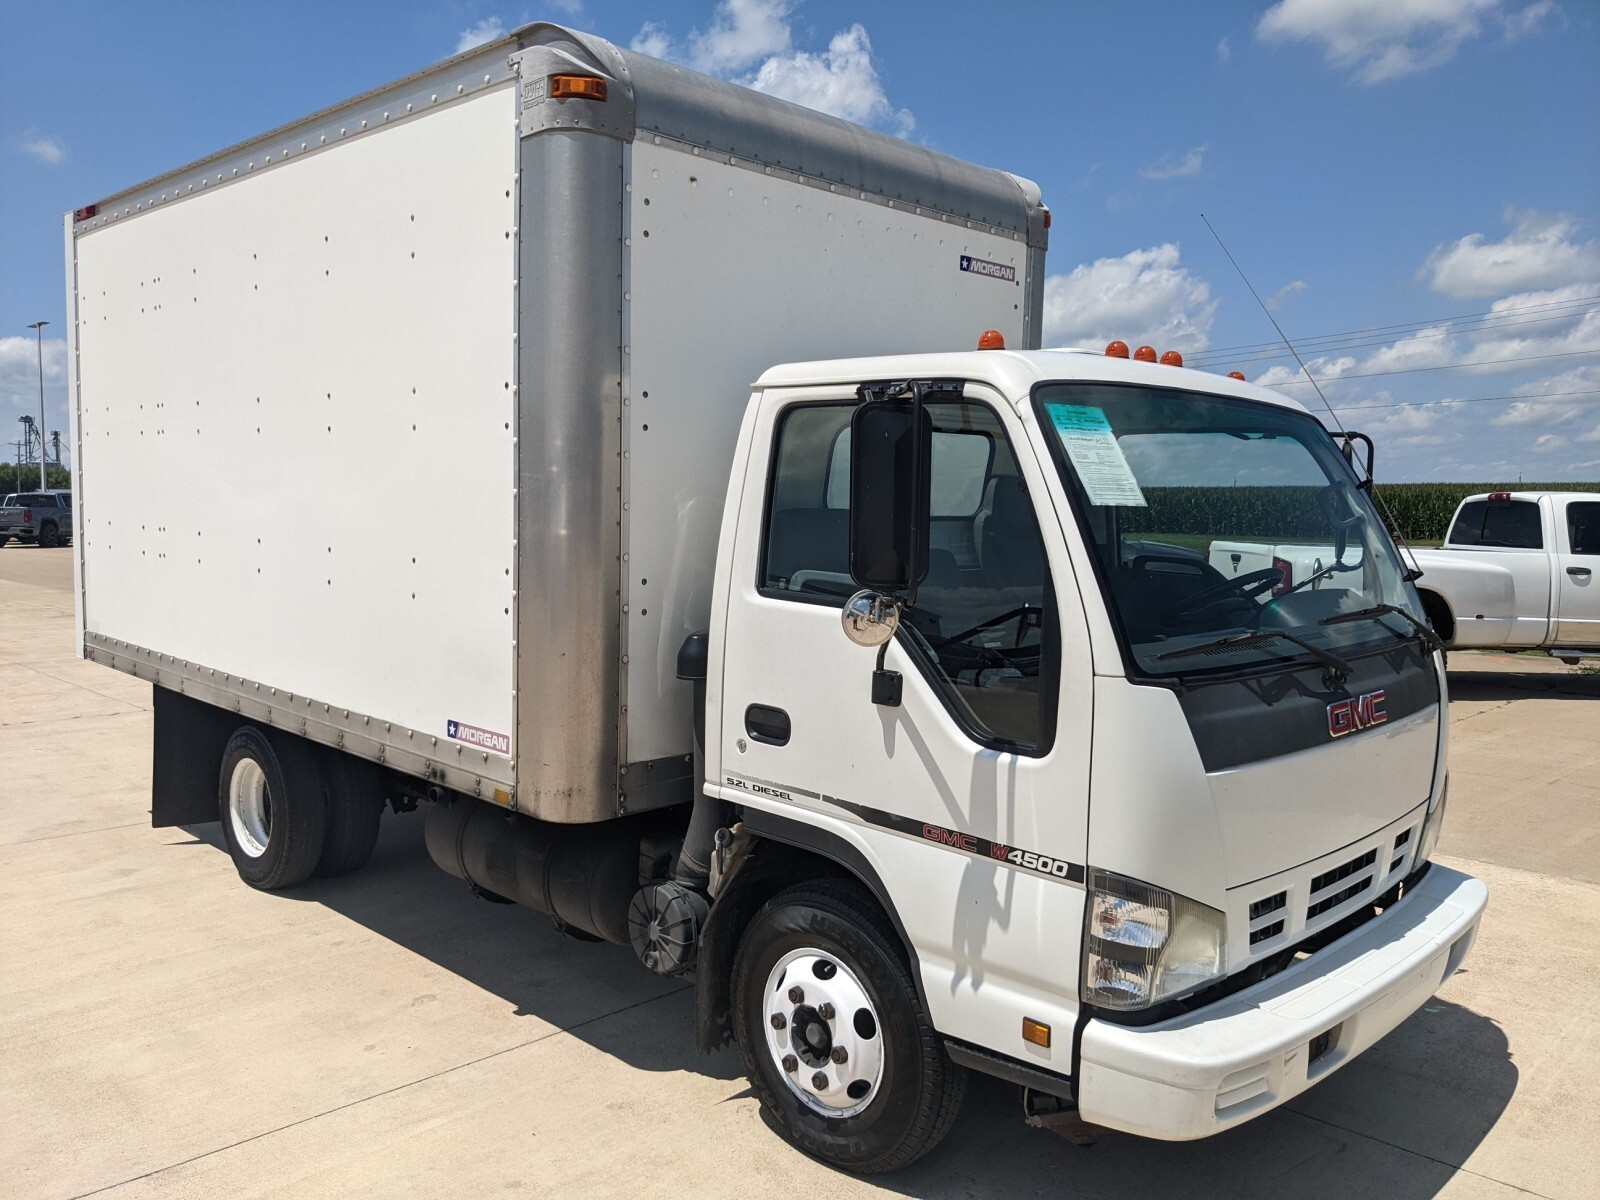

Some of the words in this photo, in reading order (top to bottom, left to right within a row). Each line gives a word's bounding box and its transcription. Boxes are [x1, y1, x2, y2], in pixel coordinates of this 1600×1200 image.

[970, 260, 1014, 280] MORGAN
[1326, 689, 1388, 737] GMC
[458, 726, 507, 751] MORGAN
[752, 784, 794, 801] DIESEL
[922, 824, 977, 853] GMC
[990, 843, 1068, 877] W4500
